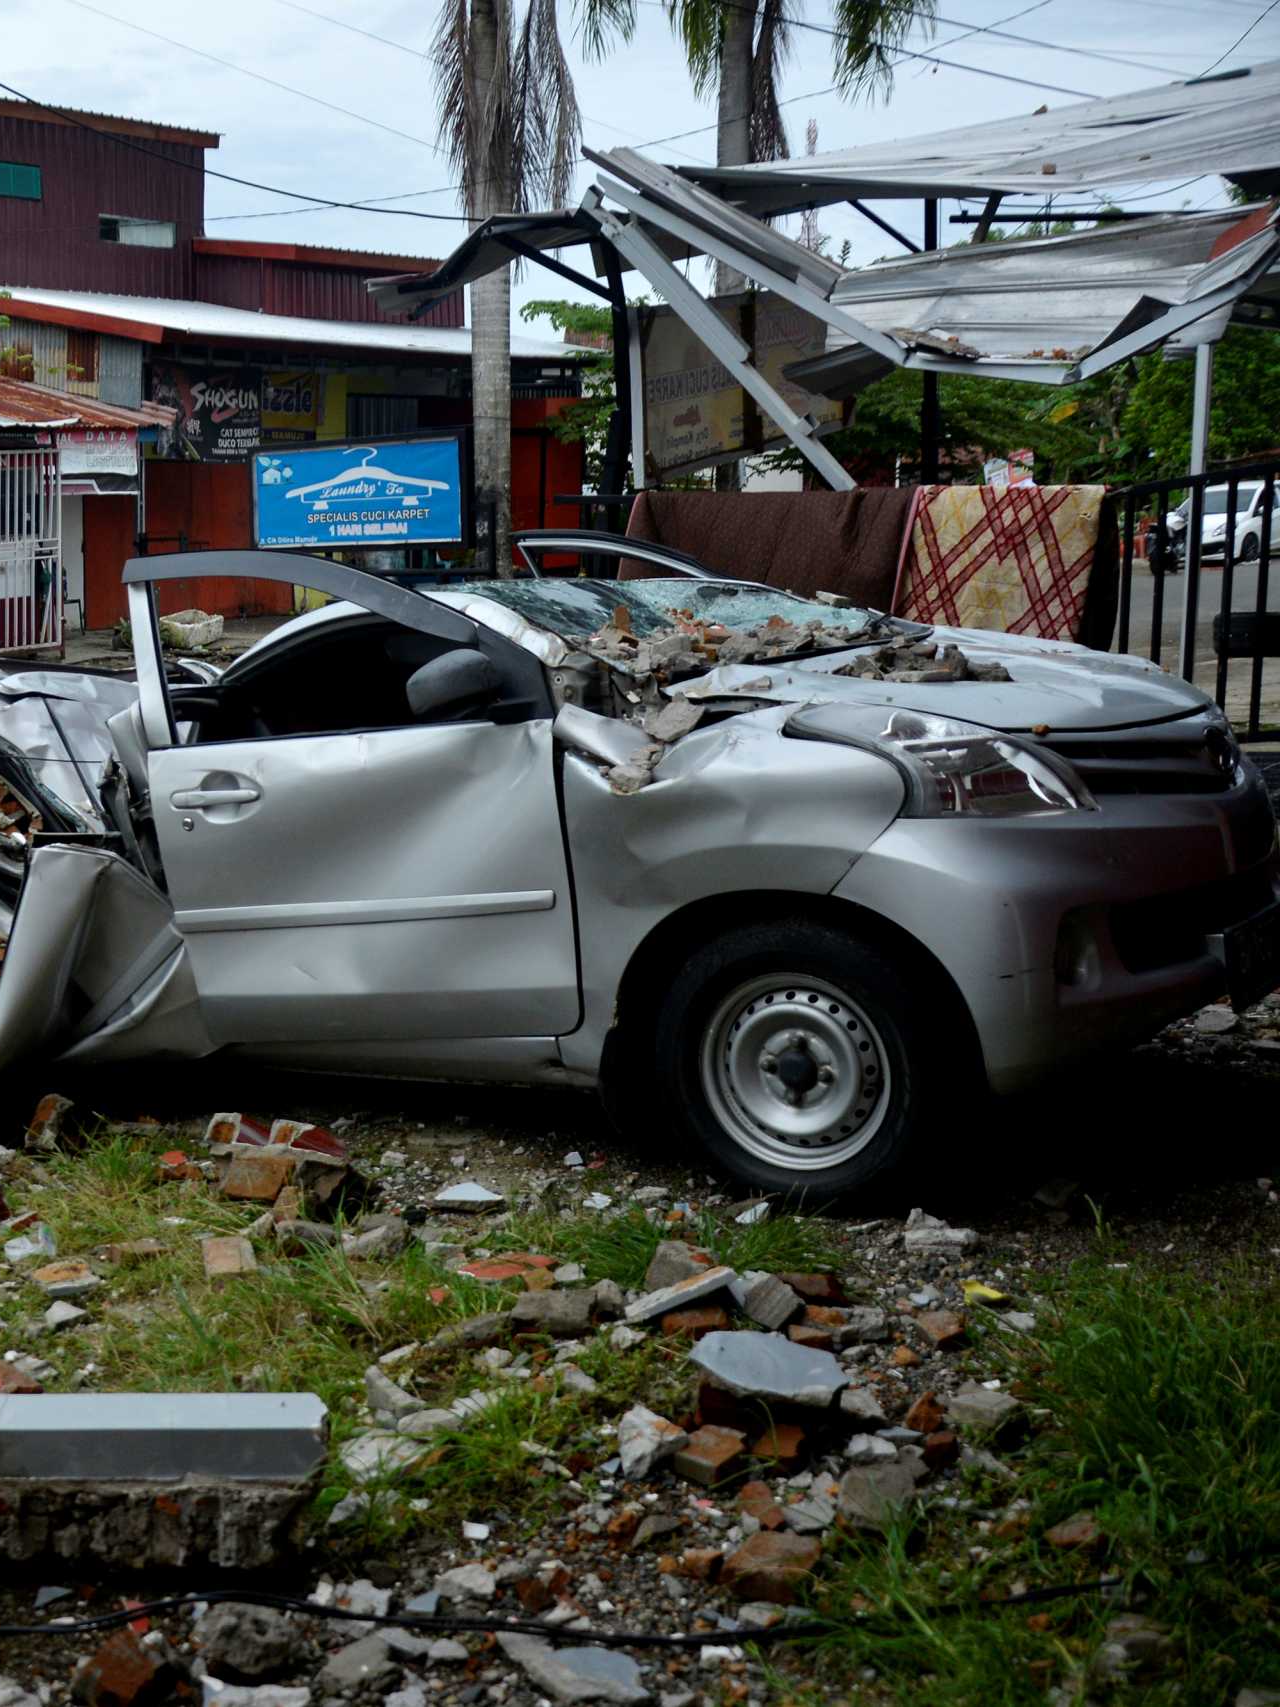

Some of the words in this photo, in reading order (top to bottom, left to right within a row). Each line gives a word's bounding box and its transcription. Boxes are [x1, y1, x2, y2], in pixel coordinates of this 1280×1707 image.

[191, 381, 259, 411] SHOGUN
[307, 511, 359, 524] SPECIALIS
[361, 509, 386, 522] CUCI
[387, 508, 431, 521] KARPET
[328, 525, 335, 536] 1
[337, 524, 363, 536] HARI
